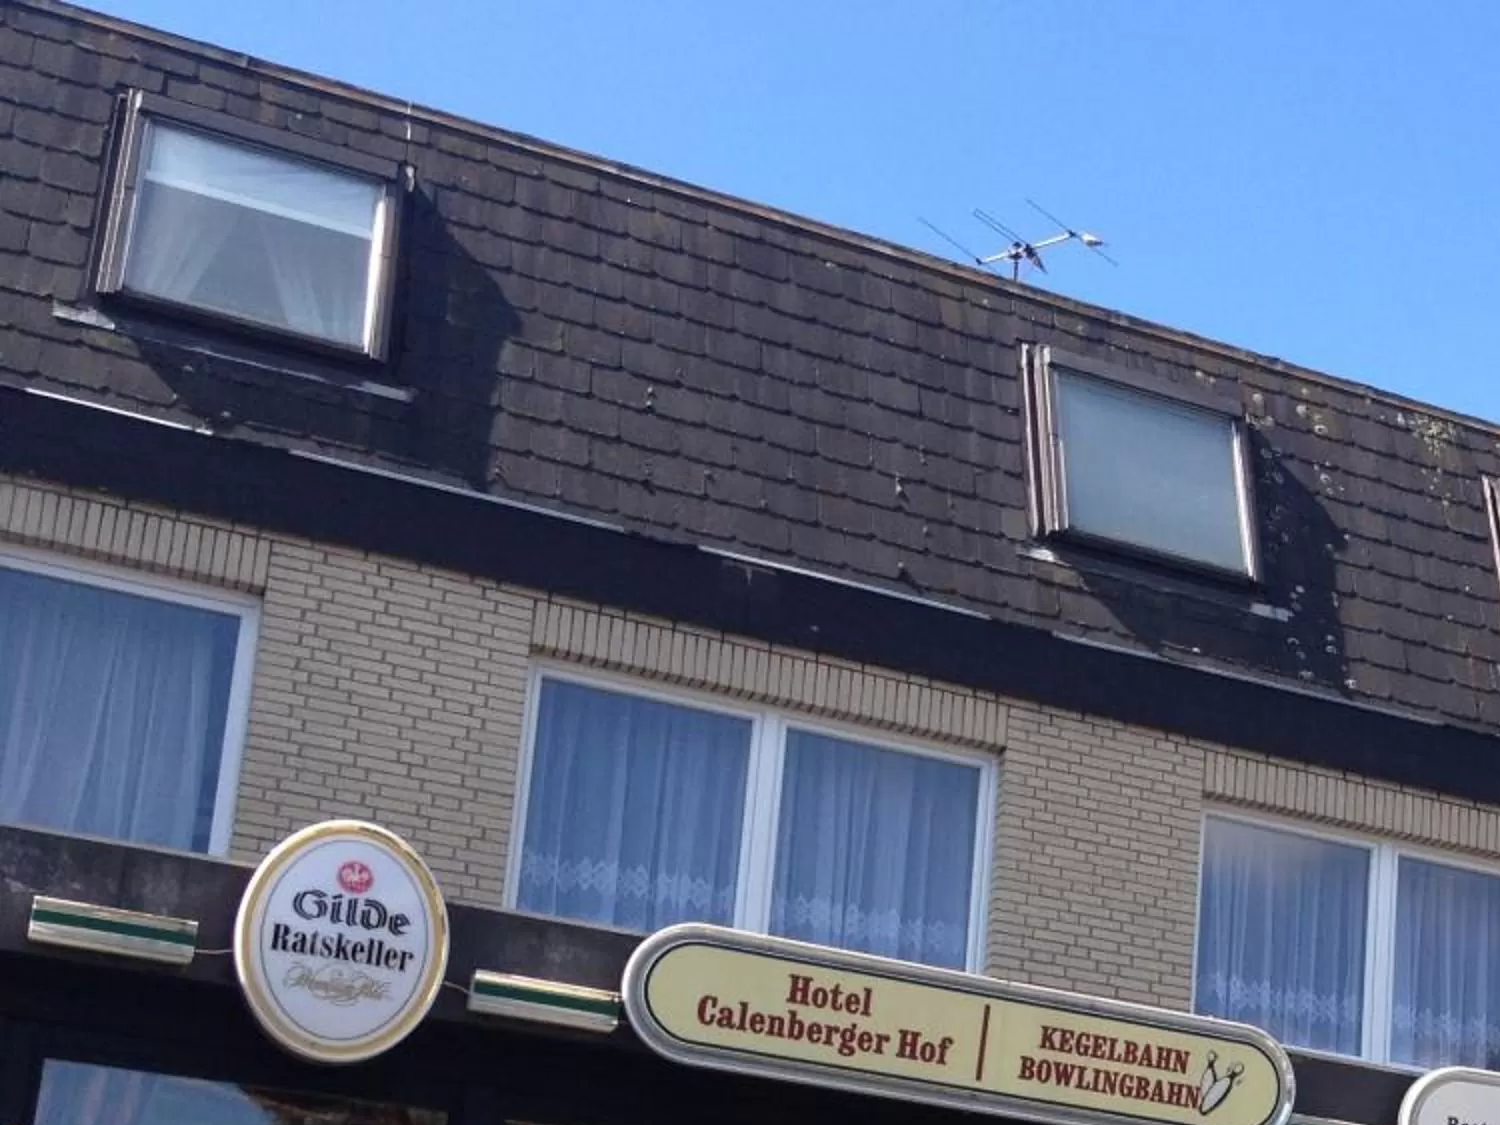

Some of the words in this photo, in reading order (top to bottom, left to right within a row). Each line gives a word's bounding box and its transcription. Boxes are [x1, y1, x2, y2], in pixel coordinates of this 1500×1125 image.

[292, 889, 410, 935] Gilde
[271, 922, 415, 973] Ratskeller
[786, 973, 873, 1017] Hotel
[697, 995, 890, 1057] Calenberger
[895, 1028, 955, 1065] Hof
[1039, 1025, 1191, 1075] KEGELBAHN
[1017, 1055, 1202, 1110] BOWLINGBAHN
